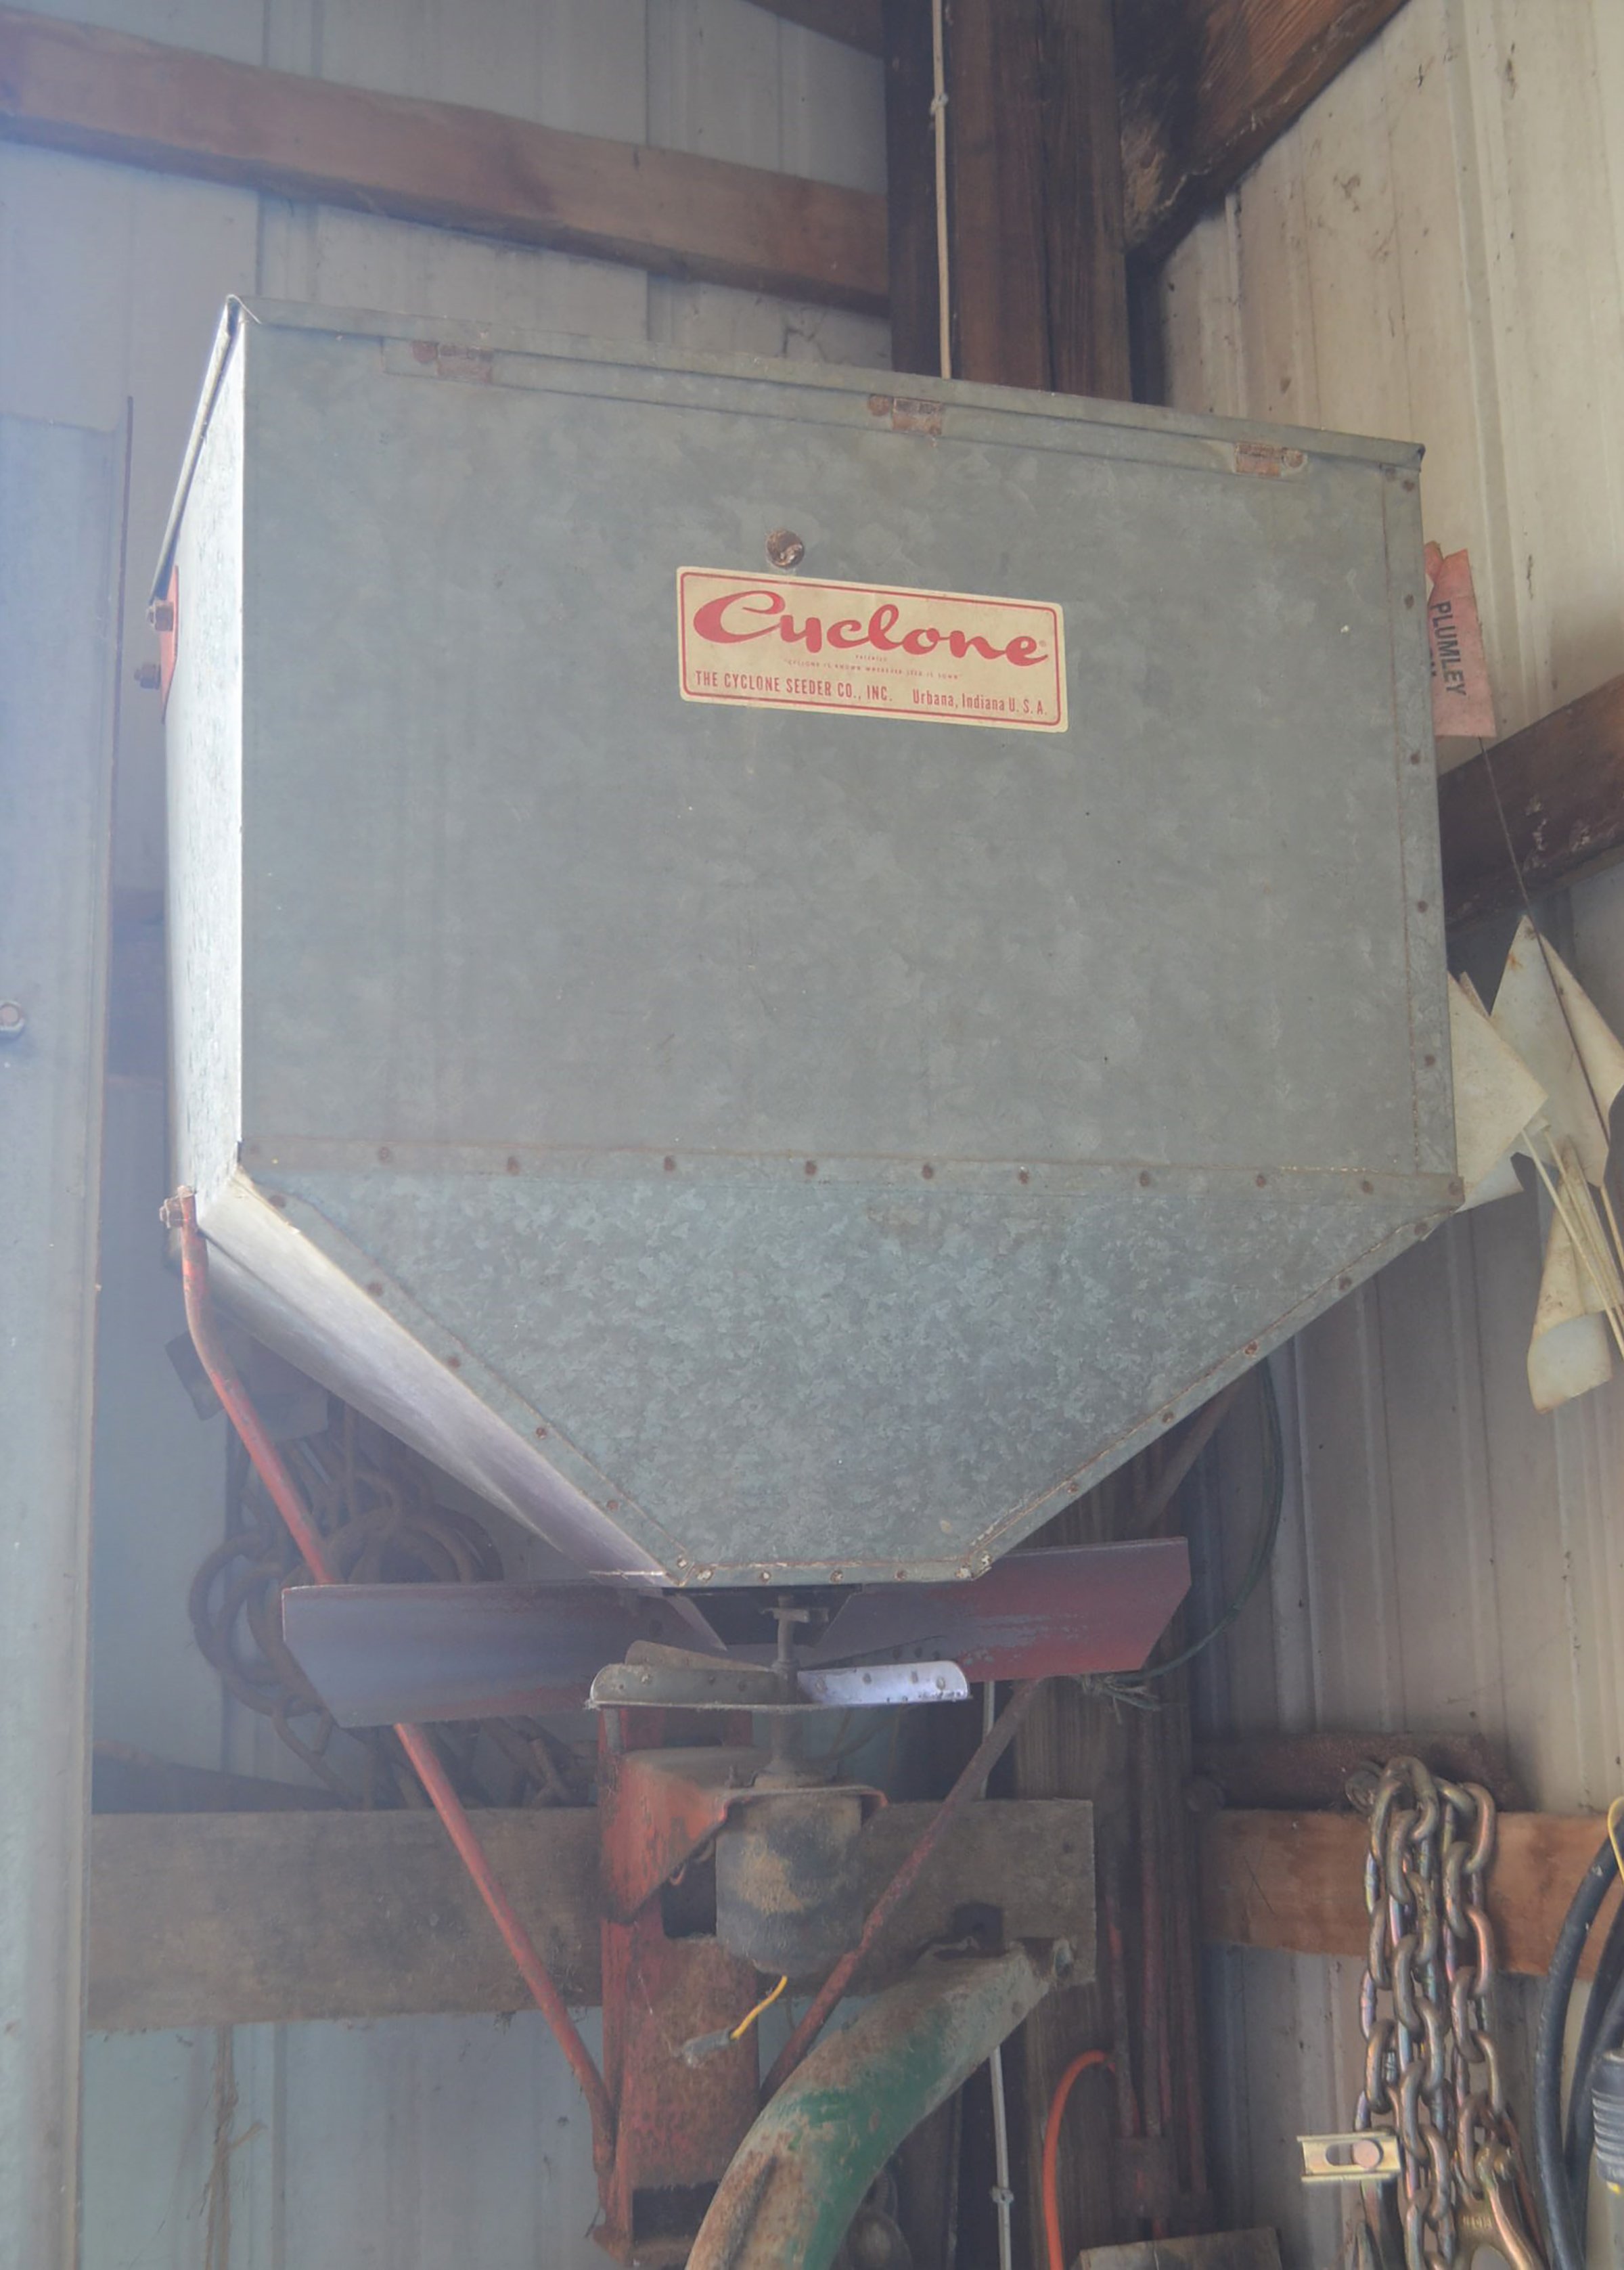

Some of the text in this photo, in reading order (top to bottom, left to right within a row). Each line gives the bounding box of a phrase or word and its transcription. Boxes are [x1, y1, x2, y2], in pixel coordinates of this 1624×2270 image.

[693, 590, 1049, 667] Cyclone
[1429, 600, 1467, 696] PLUMLEY
[696, 670, 893, 702] THE CYCLONE SEEDER CO., INC.
[913, 688, 958, 709] Urbana,
[962, 693, 1005, 711] Indiana
